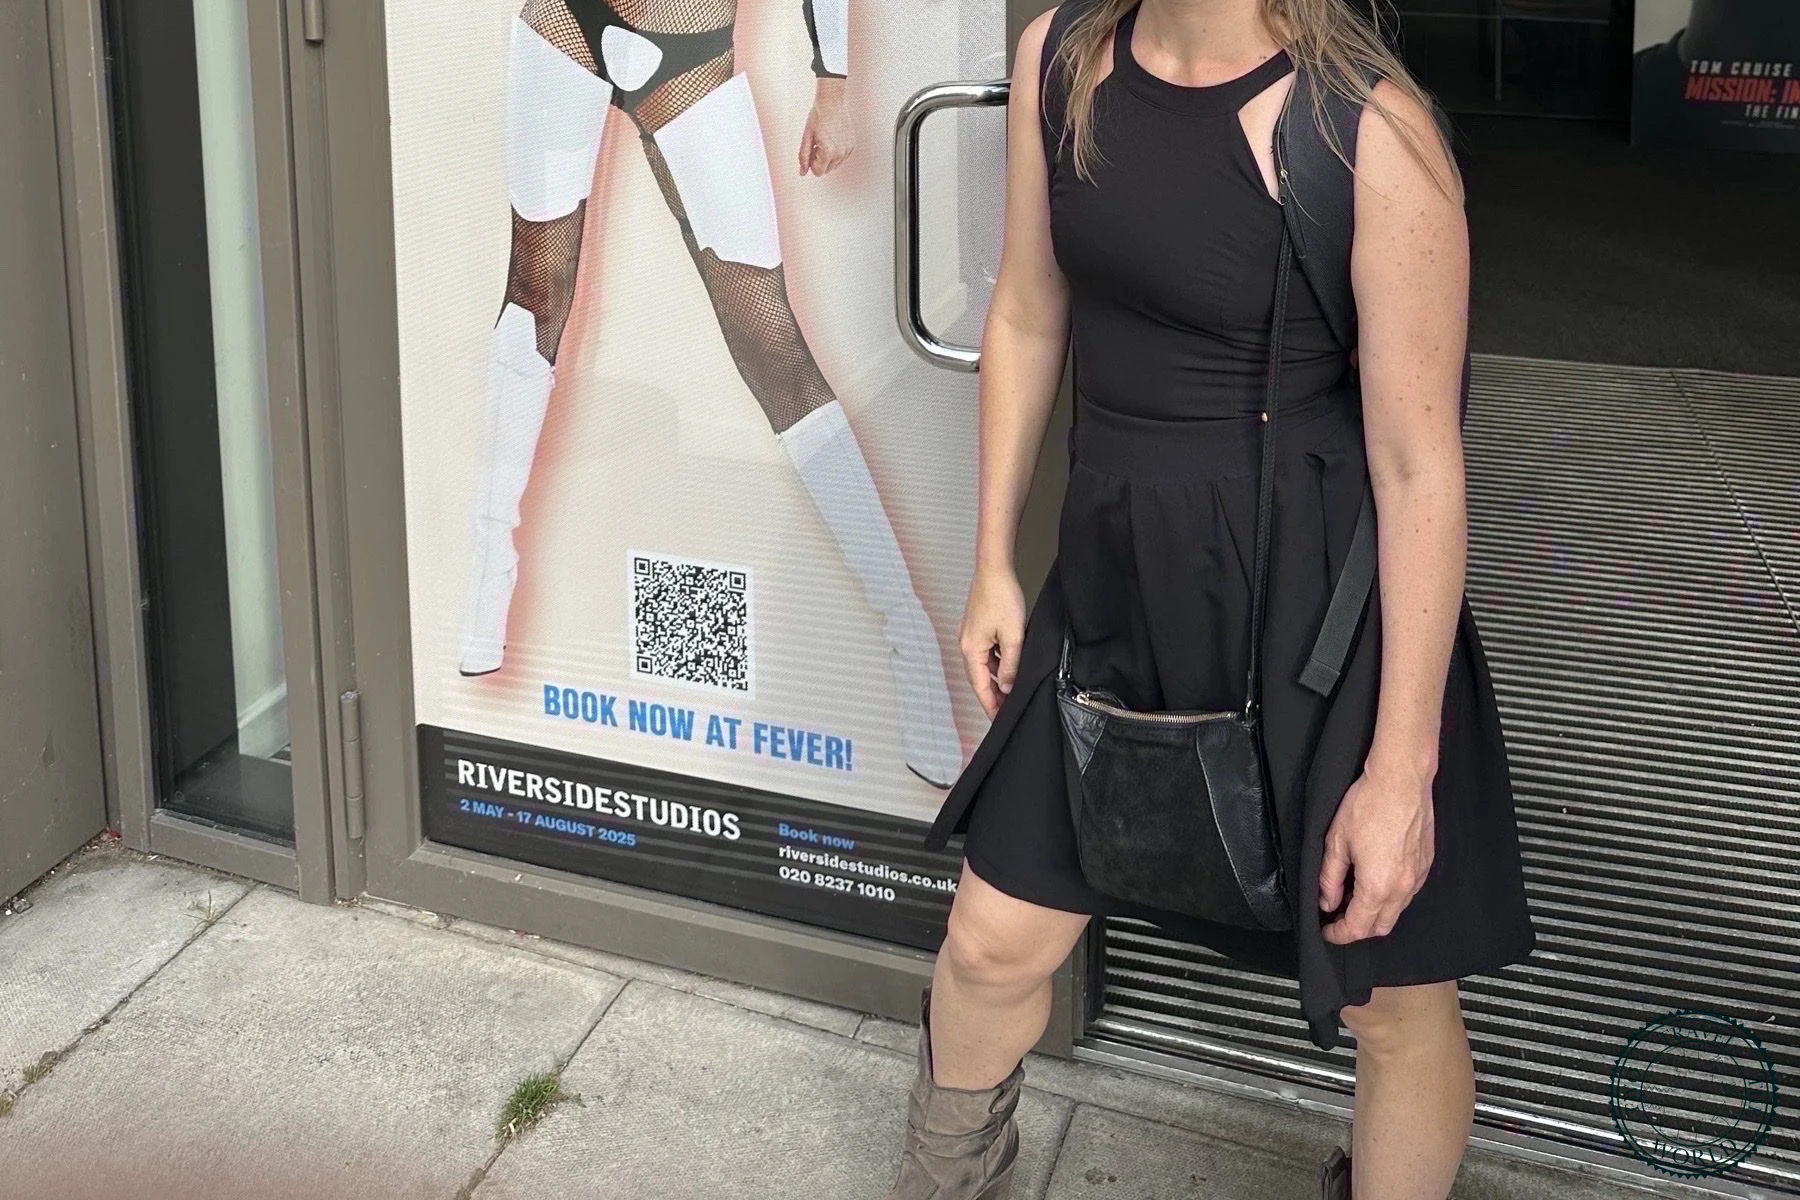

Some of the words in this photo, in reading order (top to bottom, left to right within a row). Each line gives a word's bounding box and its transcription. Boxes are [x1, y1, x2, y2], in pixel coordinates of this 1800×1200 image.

[1690, 60, 1722, 74] TOM
[1730, 61, 1793, 77] CRUISE
[1685, 76, 1777, 103] MISSION:
[1745, 104, 1769, 118] THE
[1775, 105, 1800, 120] FIN
[544, 683, 618, 728] BOOK
[628, 701, 695, 742] NOW
[705, 715, 741, 750] AT
[753, 722, 854, 772] FEVER!
[460, 798, 471, 811] 2
[471, 801, 505, 820] MAY
[516, 811, 531, 826] 17
[534, 815, 596, 838] AUGUST
[598, 828, 637, 847] 2025
[778, 822, 819, 844] Book
[822, 834, 855, 851] now
[778, 844, 957, 893] riversidestudios.co.uk
[778, 866, 811, 885] 020
[814, 870, 854, 891] 8237
[857, 881, 896, 902] 1010
